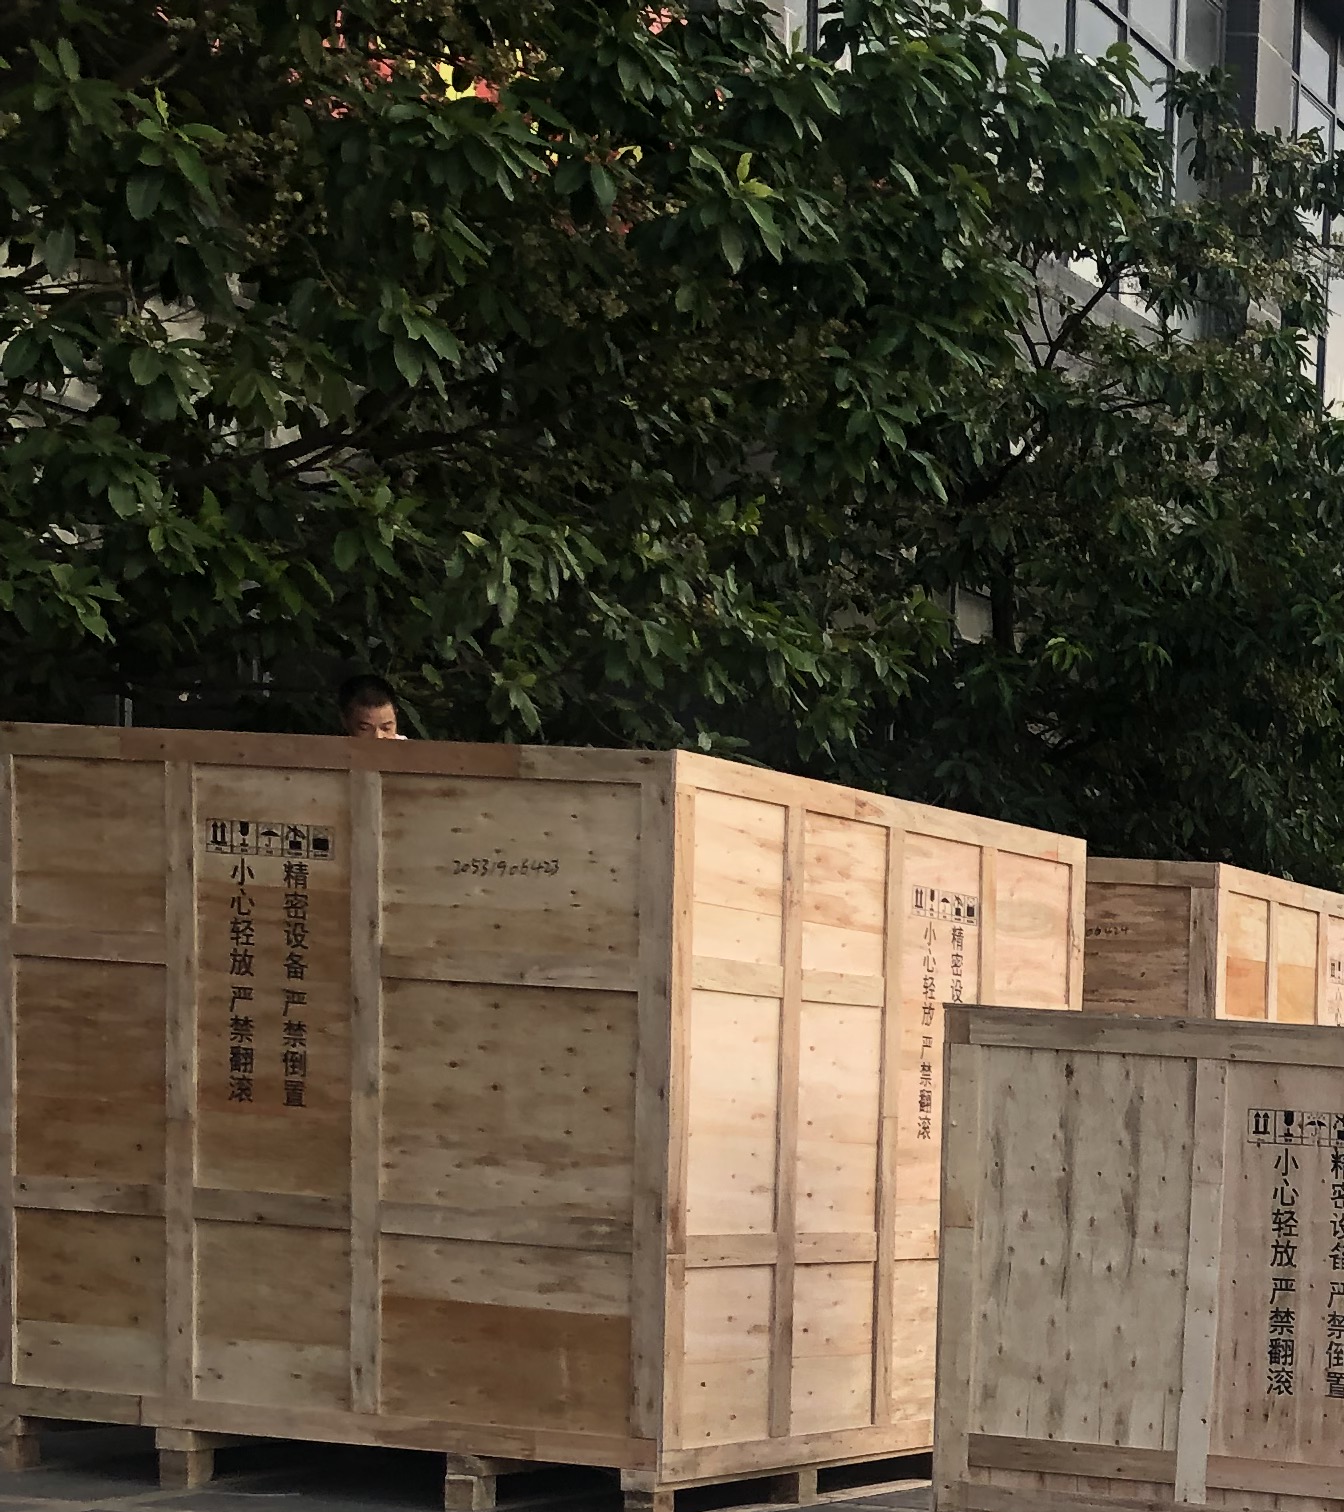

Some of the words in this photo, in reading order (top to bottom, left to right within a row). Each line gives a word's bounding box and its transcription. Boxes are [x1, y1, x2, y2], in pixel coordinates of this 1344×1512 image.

[229, 858, 255, 977] 小心轻放
[283, 860, 309, 981] 精密设备
[921, 921, 937, 1026] 小心轻放
[228, 985, 255, 1103] 严禁翻滚
[282, 988, 307, 1108] 严禁倒置
[917, 1036, 934, 1140] 严禁翻滚
[1270, 1148, 1299, 1268] 小心轻放
[1266, 1277, 1296, 1396] 严禁翻滚
